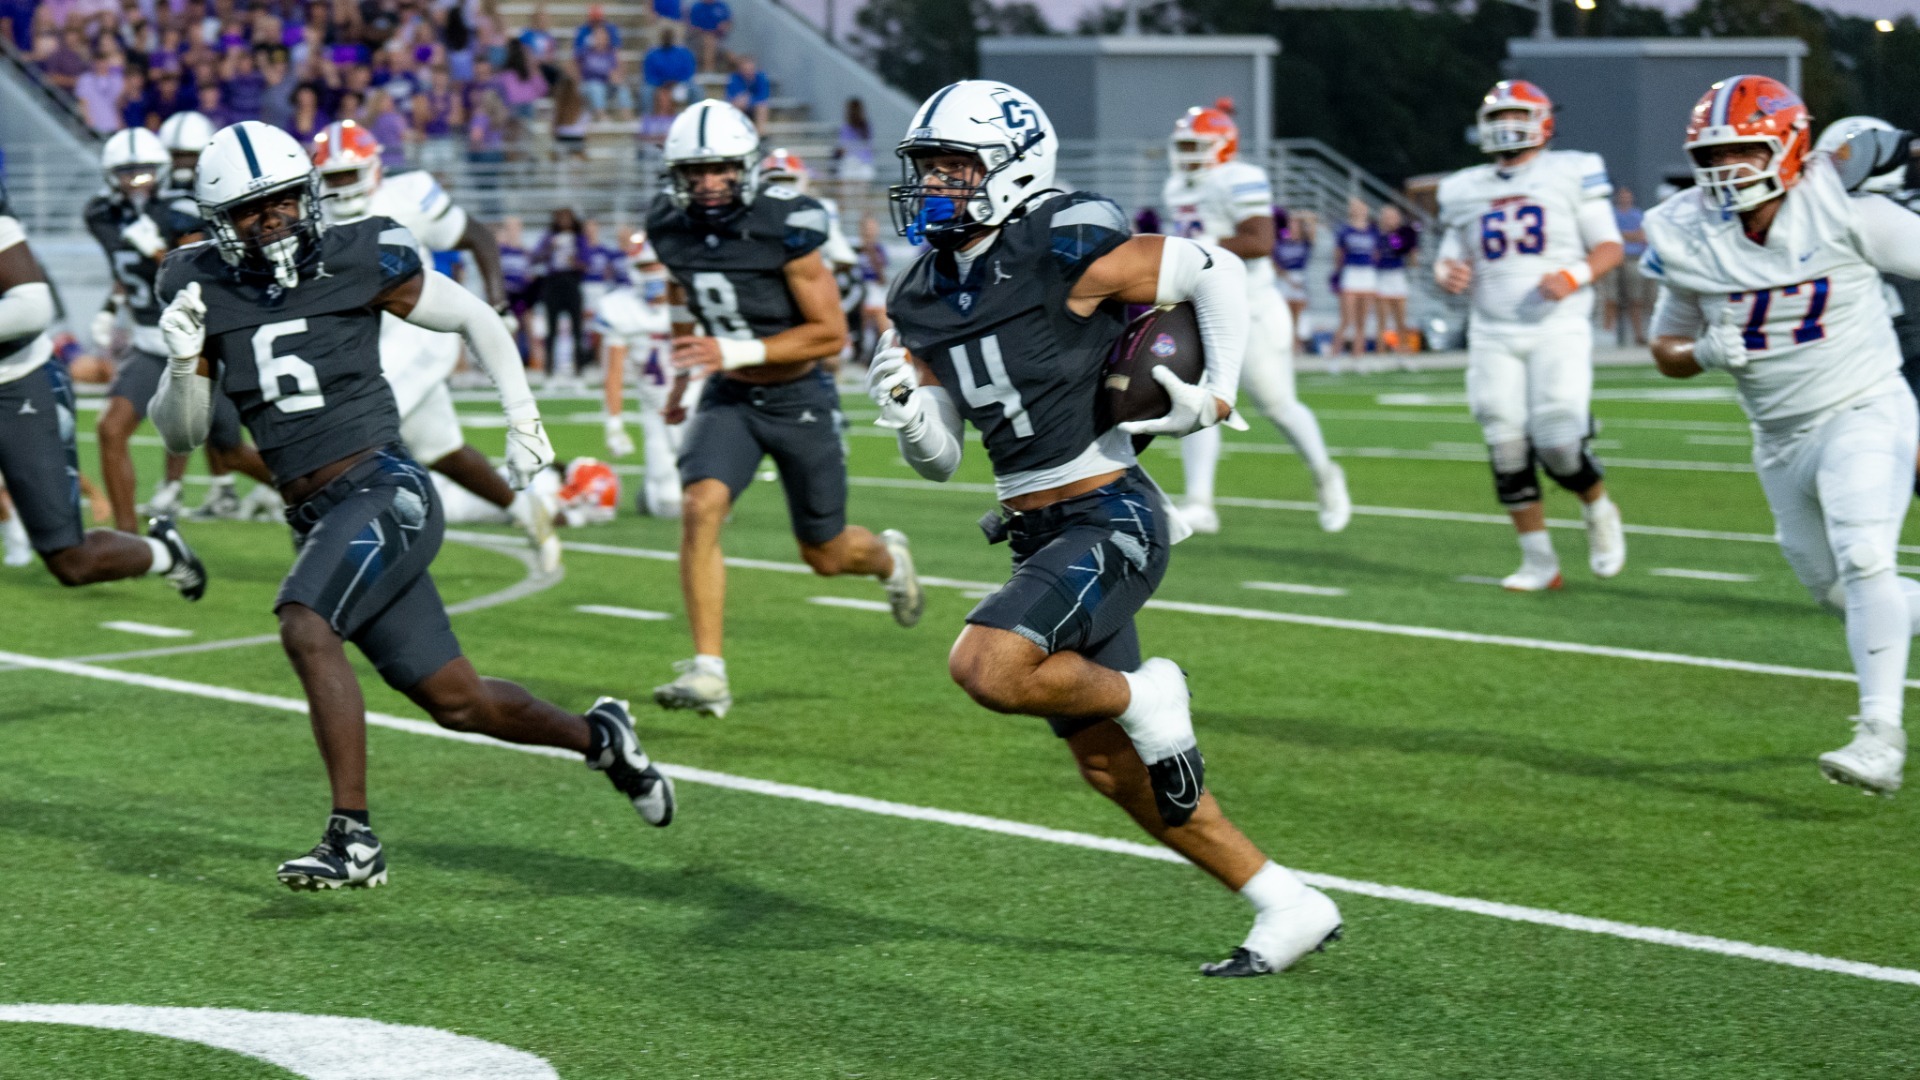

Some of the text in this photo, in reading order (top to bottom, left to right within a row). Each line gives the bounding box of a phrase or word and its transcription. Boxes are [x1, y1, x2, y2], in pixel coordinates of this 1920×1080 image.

[1480, 204, 1546, 261] 63
[113, 251, 151, 308] 5
[692, 271, 755, 340] 8
[1729, 276, 1830, 351] 77
[251, 318, 326, 413] 6
[949, 334, 1035, 438] 4
